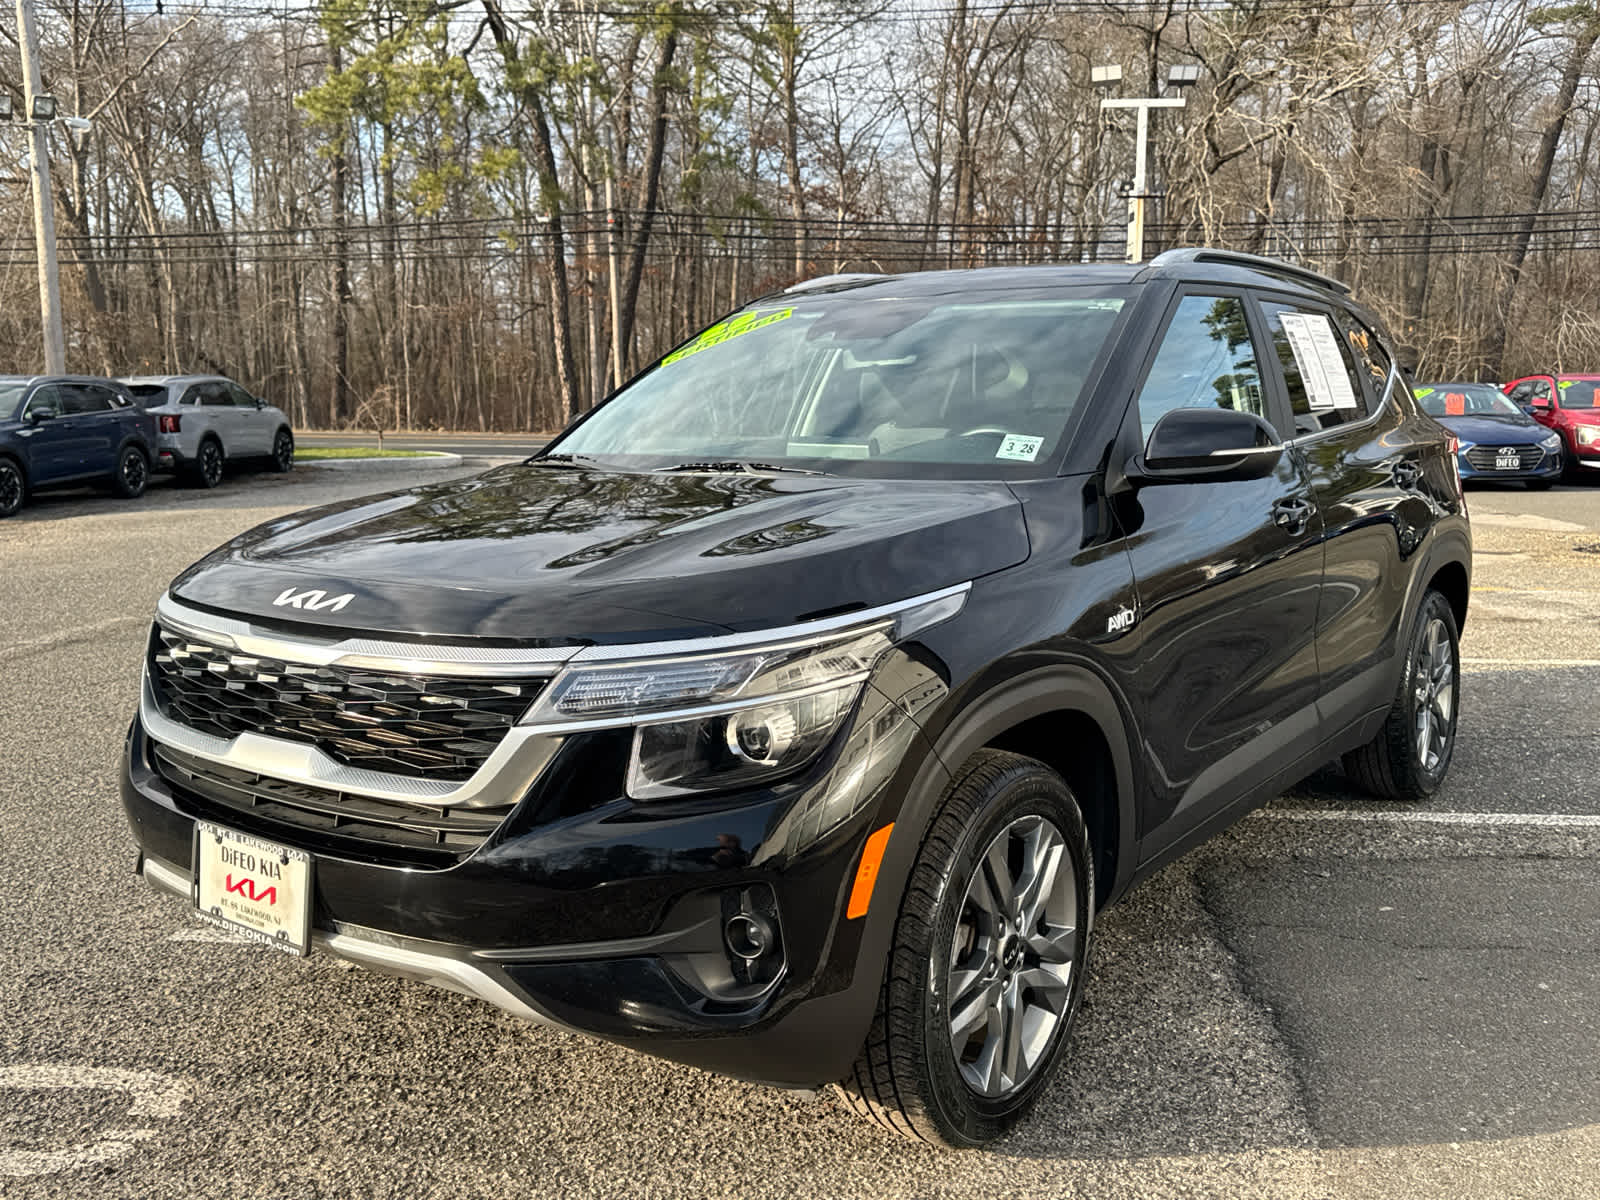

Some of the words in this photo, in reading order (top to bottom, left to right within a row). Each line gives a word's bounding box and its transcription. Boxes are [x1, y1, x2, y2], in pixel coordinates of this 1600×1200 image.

[1006, 442, 1015, 452] 3
[1020, 443, 1035, 454] 28
[272, 587, 356, 612] KIA
[1107, 610, 1134, 633] AWD
[221, 846, 256, 872] DiFEO
[260, 858, 282, 880] KIA
[225, 873, 277, 906] KIA
[194, 911, 301, 956] www.DIFEOKIA.com
